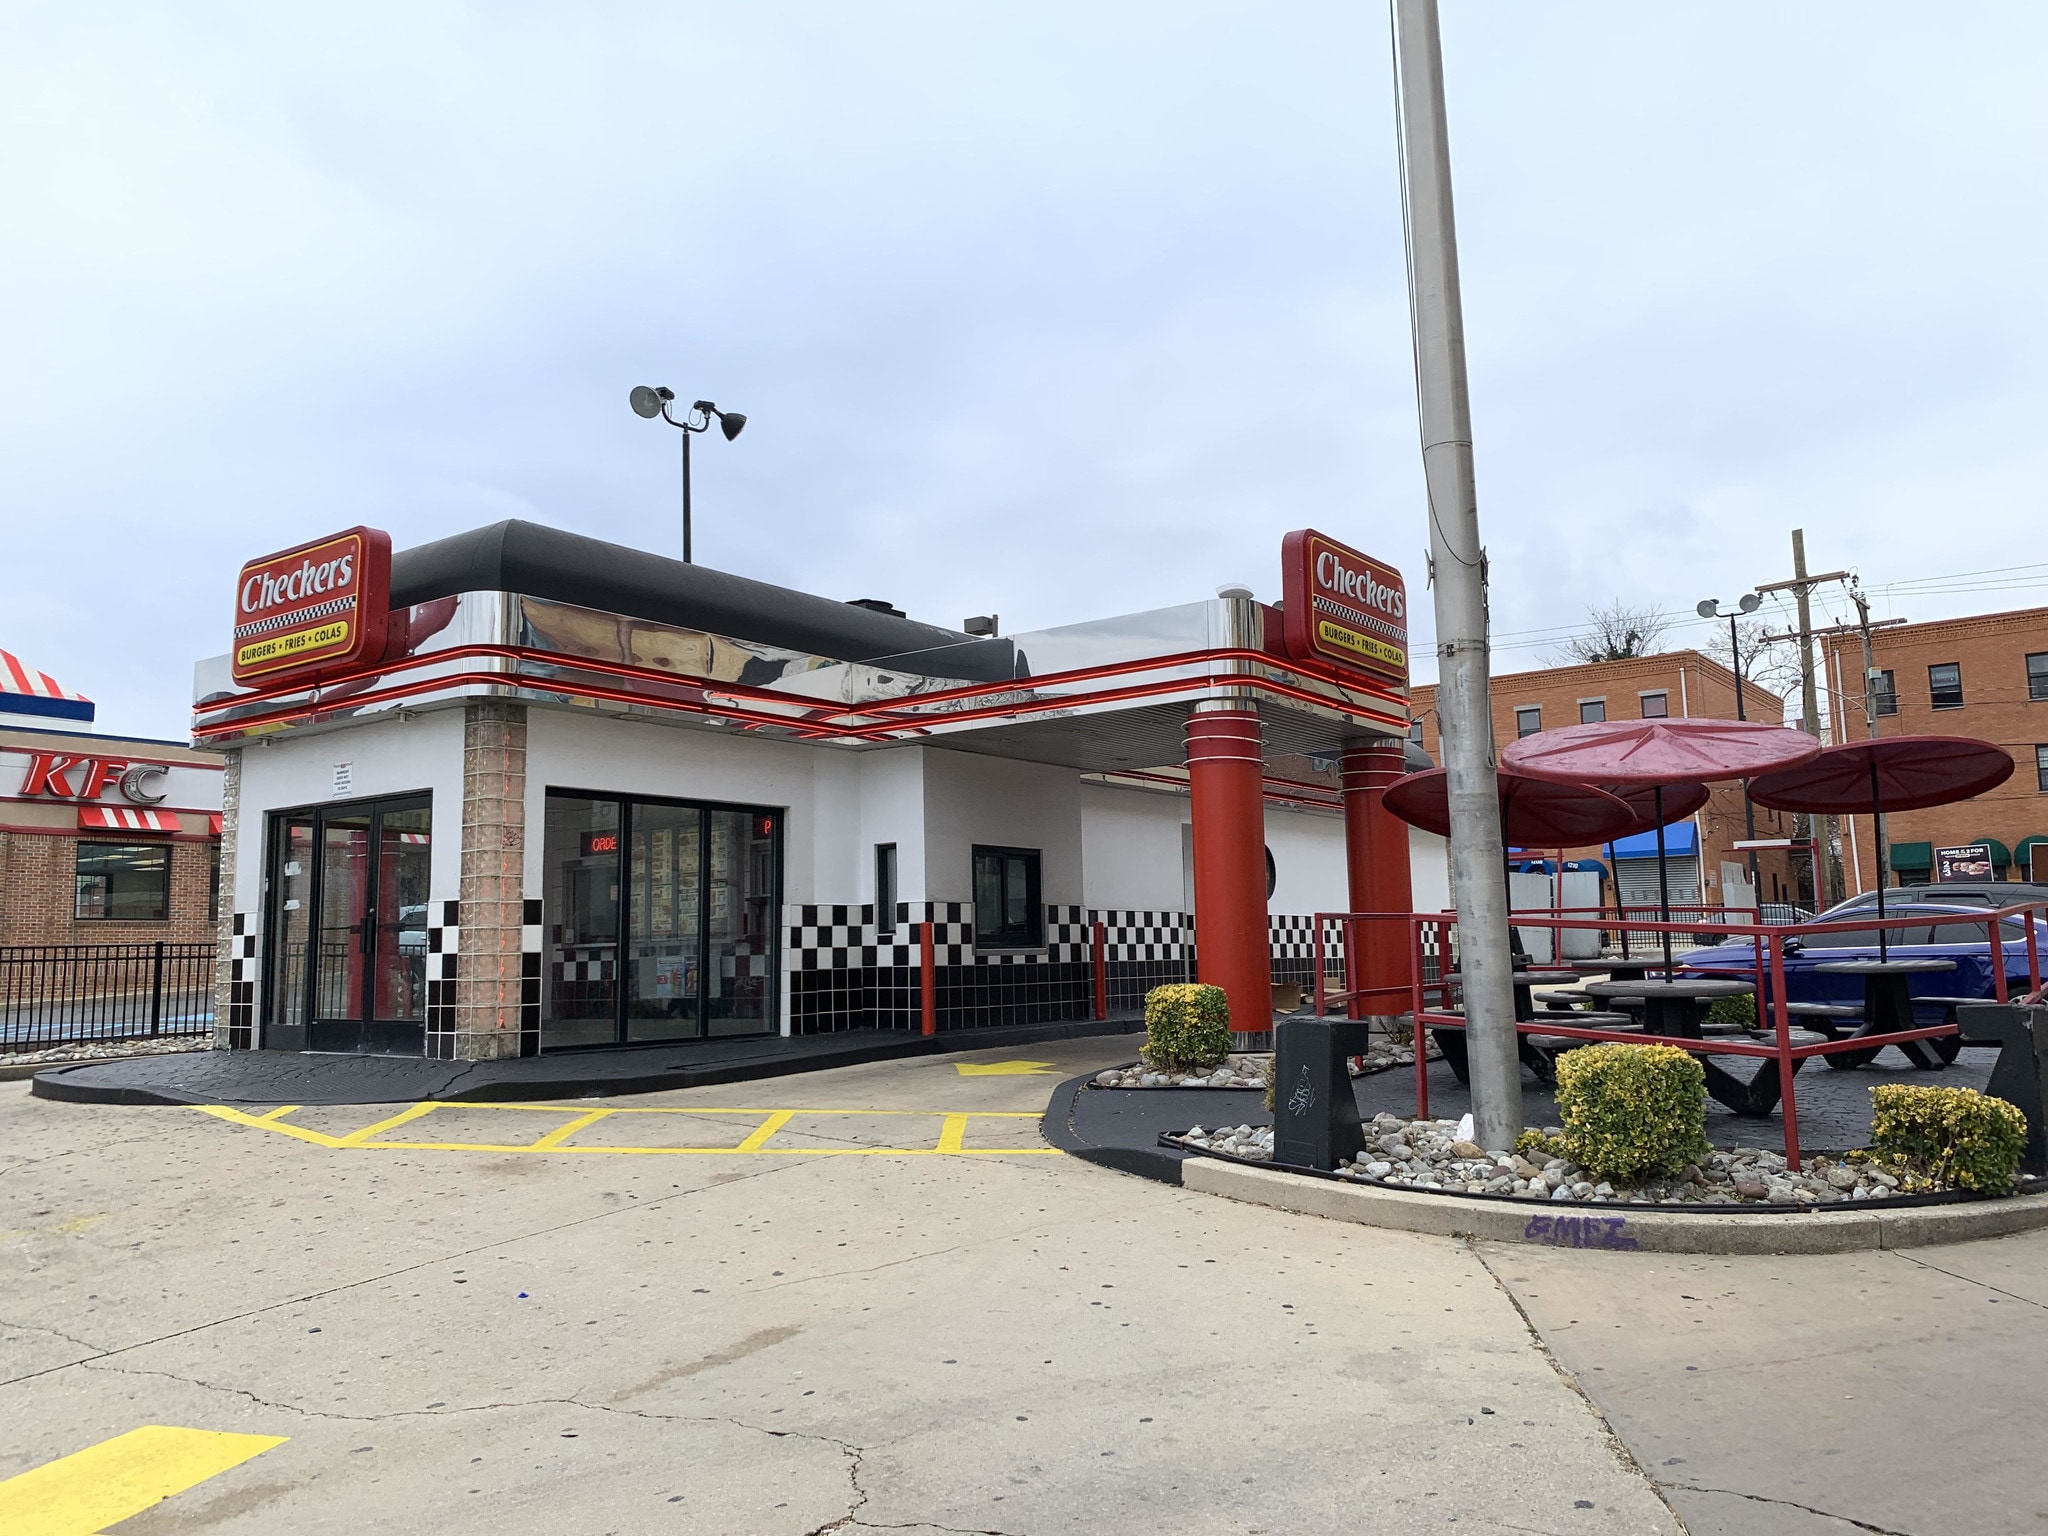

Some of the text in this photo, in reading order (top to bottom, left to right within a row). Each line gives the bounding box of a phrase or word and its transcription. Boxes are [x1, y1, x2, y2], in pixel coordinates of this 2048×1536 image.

[241, 554, 353, 614] Checkers
[1316, 551, 1404, 619] Checkers
[241, 626, 341, 661] BURGERS FRIES COLAS
[1324, 625, 1403, 663] BURGERS FRIES COLAS
[18, 753, 170, 805] KFC
